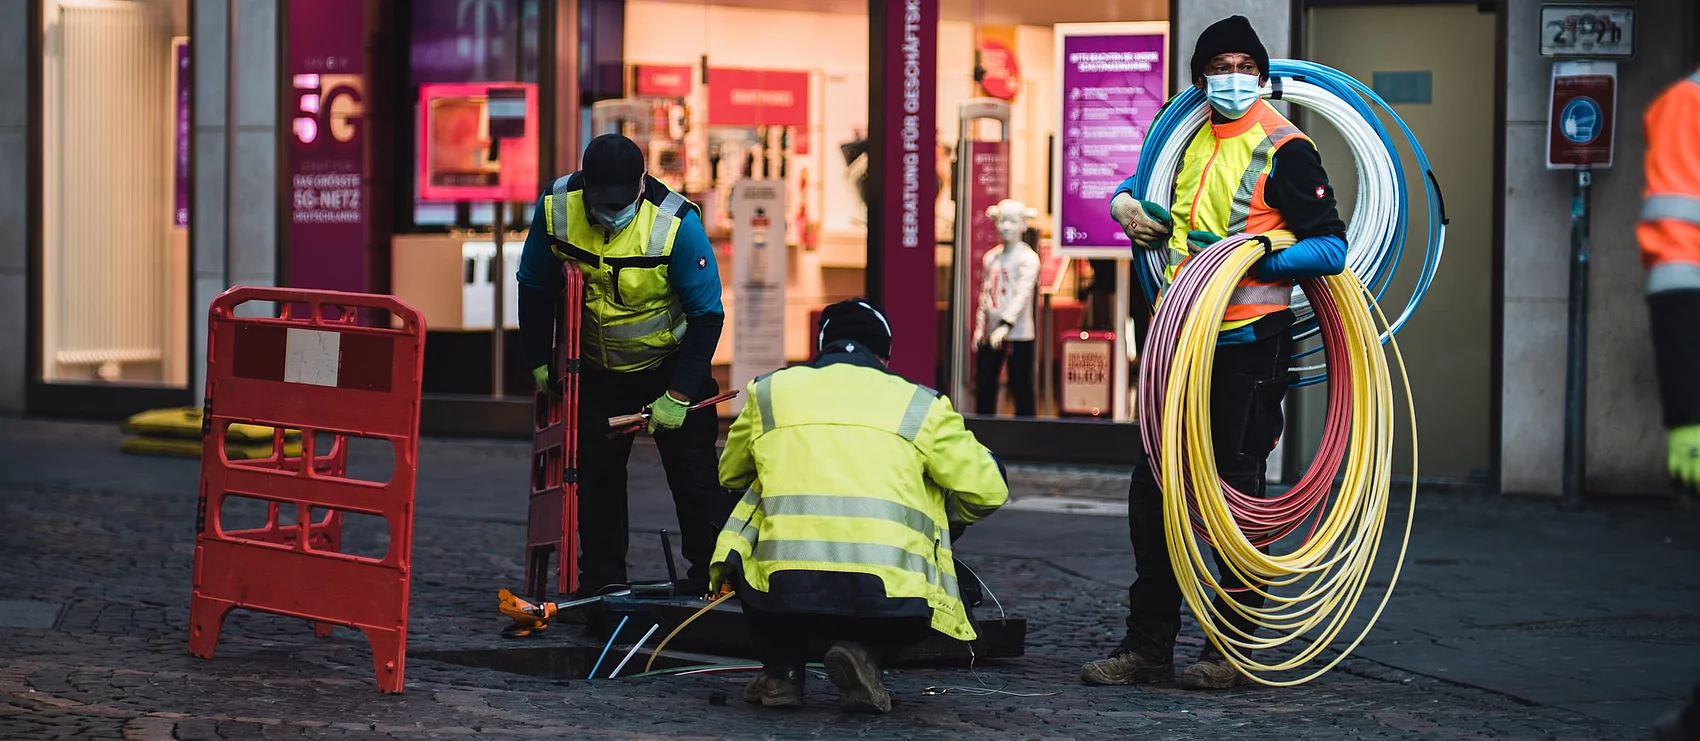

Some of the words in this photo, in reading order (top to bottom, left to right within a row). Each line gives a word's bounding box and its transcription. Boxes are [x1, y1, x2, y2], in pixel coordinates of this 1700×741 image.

[293, 74, 365, 143] 5G
[901, 115, 919, 151] FÜR
[293, 189, 361, 209] 5G-NETZ
[903, 153, 919, 247] BERATUNG
